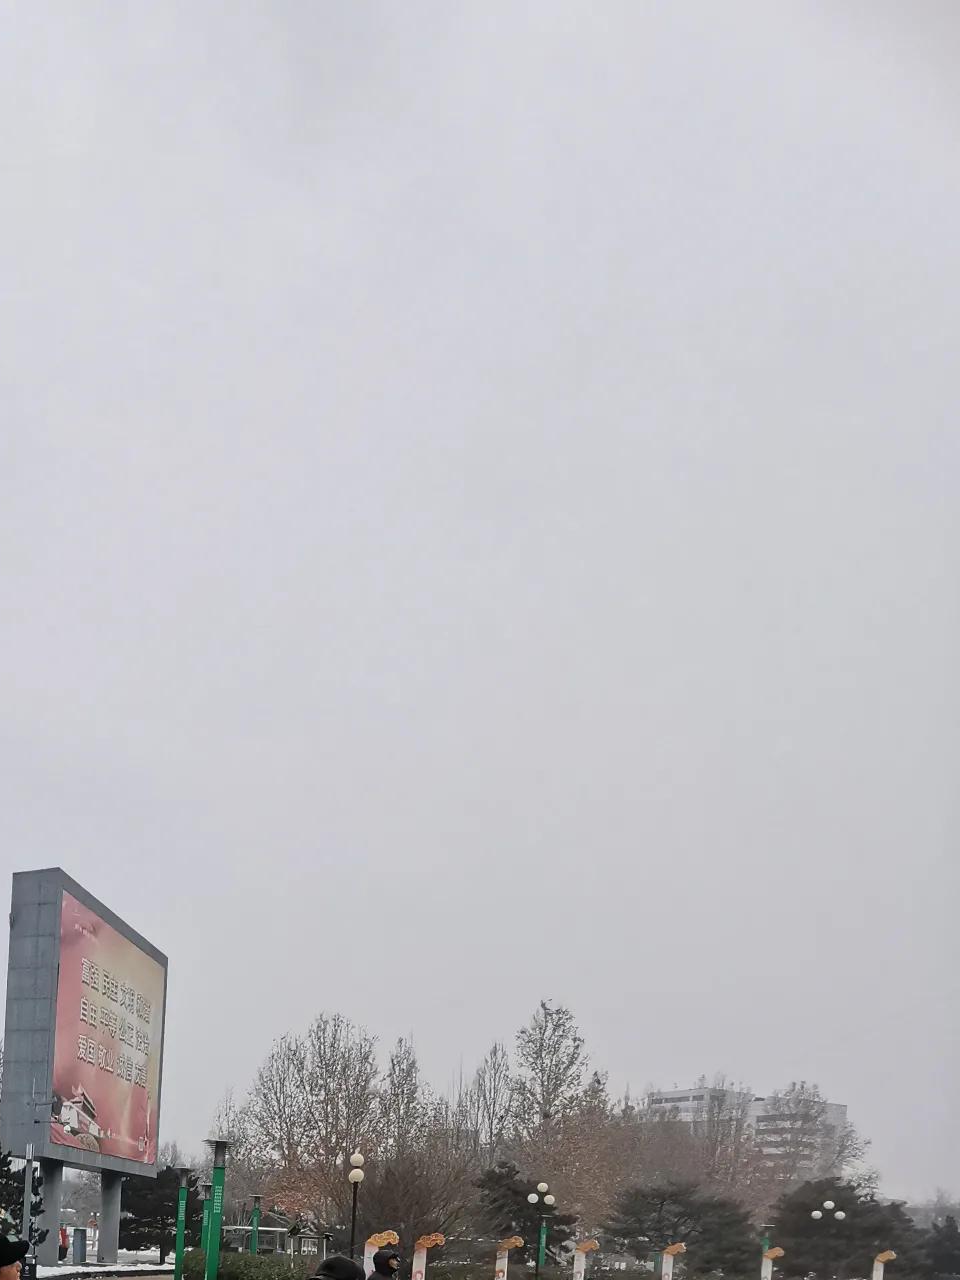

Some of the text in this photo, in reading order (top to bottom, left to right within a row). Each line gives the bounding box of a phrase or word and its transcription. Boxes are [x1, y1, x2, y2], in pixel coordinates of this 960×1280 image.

[81, 957, 100, 992] 富强
[120, 981, 135, 1014] 文明
[80, 996, 98, 1029] 自由
[100, 1006, 118, 1039] 平等
[77, 1034, 96, 1066] 爱国
[97, 1044, 115, 1074] 敬业
